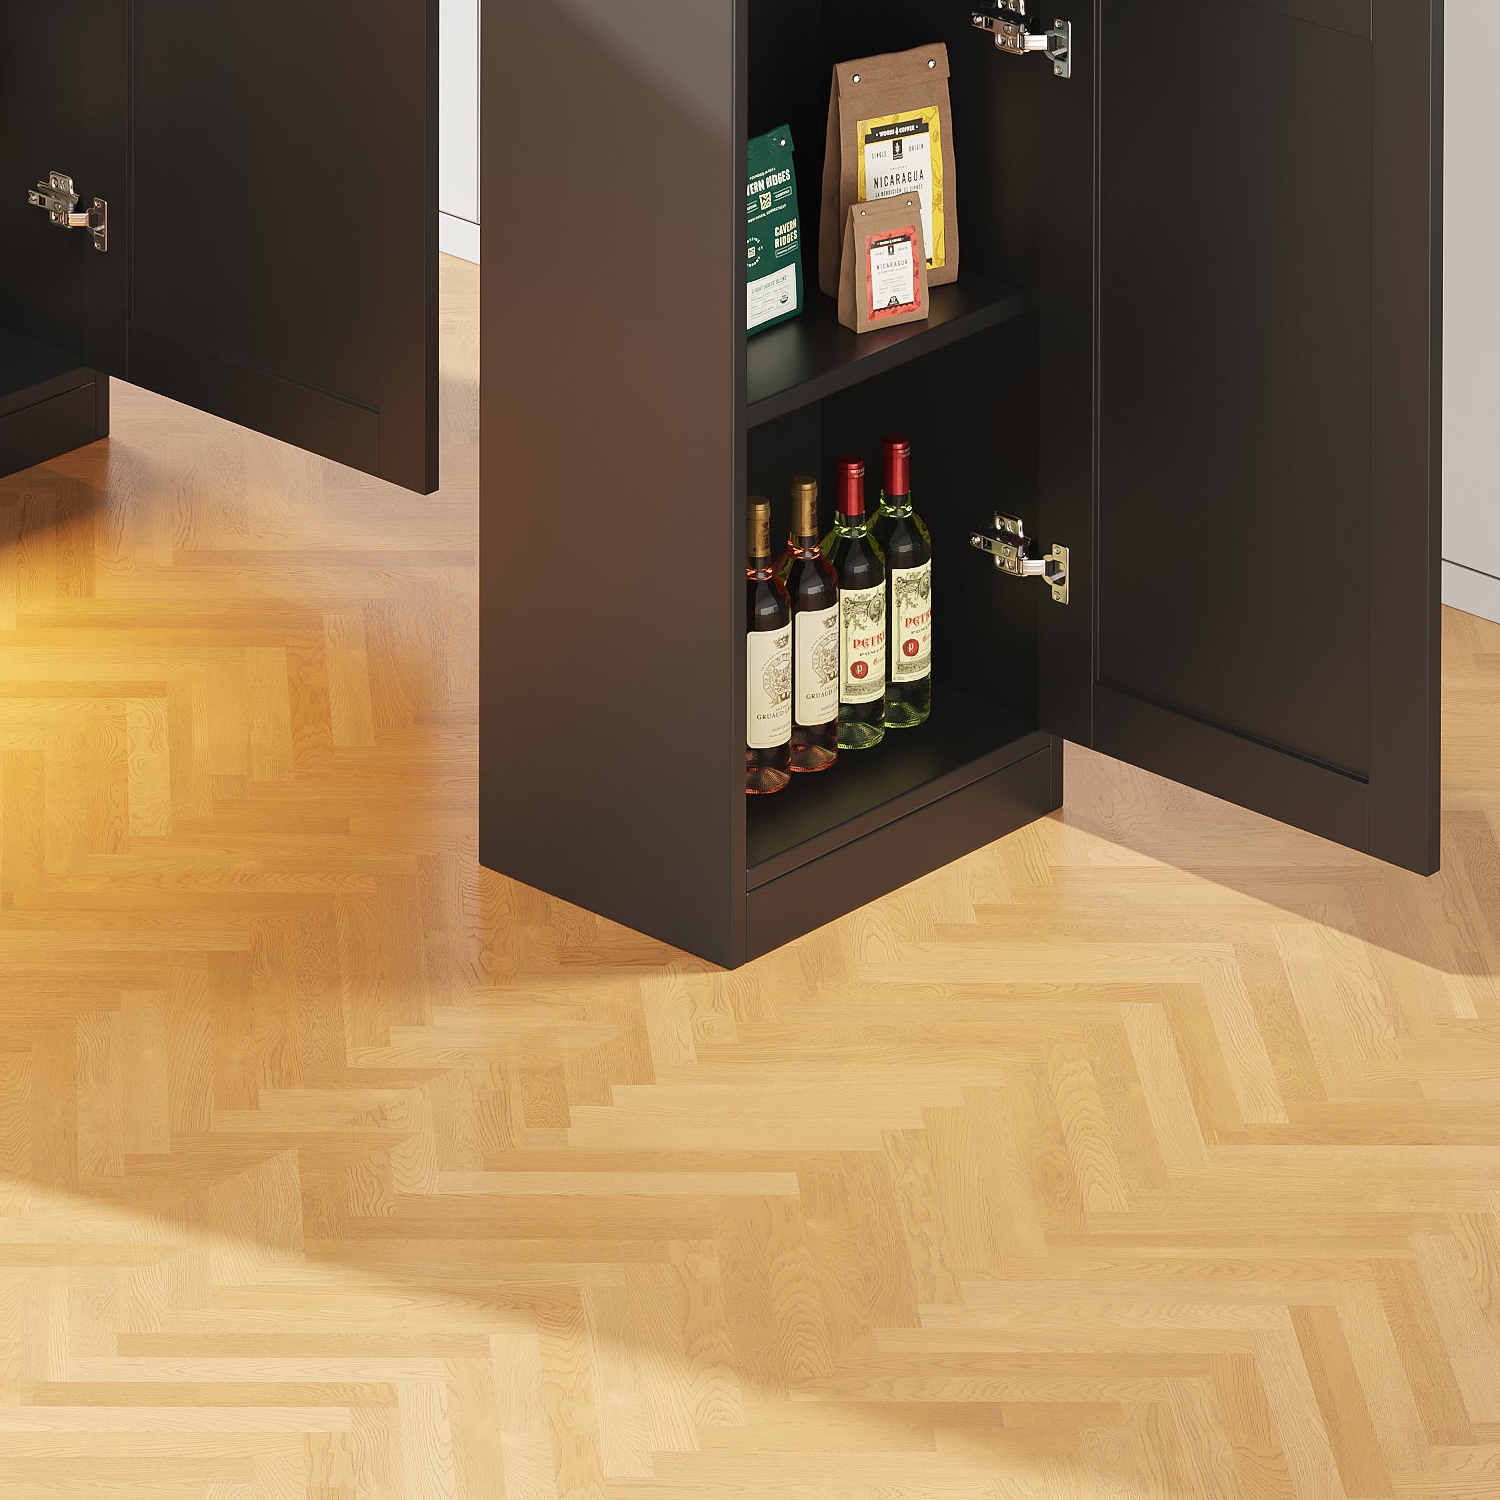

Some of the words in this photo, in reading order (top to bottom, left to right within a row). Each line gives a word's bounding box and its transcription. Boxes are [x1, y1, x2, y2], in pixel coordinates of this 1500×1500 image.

[871, 150, 887, 160] SINGLE
[908, 143, 924, 152] ORIGIN
[766, 168, 791, 189] RIDGES
[873, 169, 924, 189] NICARAGUA
[774, 218, 797, 237] CAVERN
[774, 229, 798, 249] RIDGES
[876, 259, 908, 270] NICARAGUA
[805, 689, 832, 700] GRUAUD
